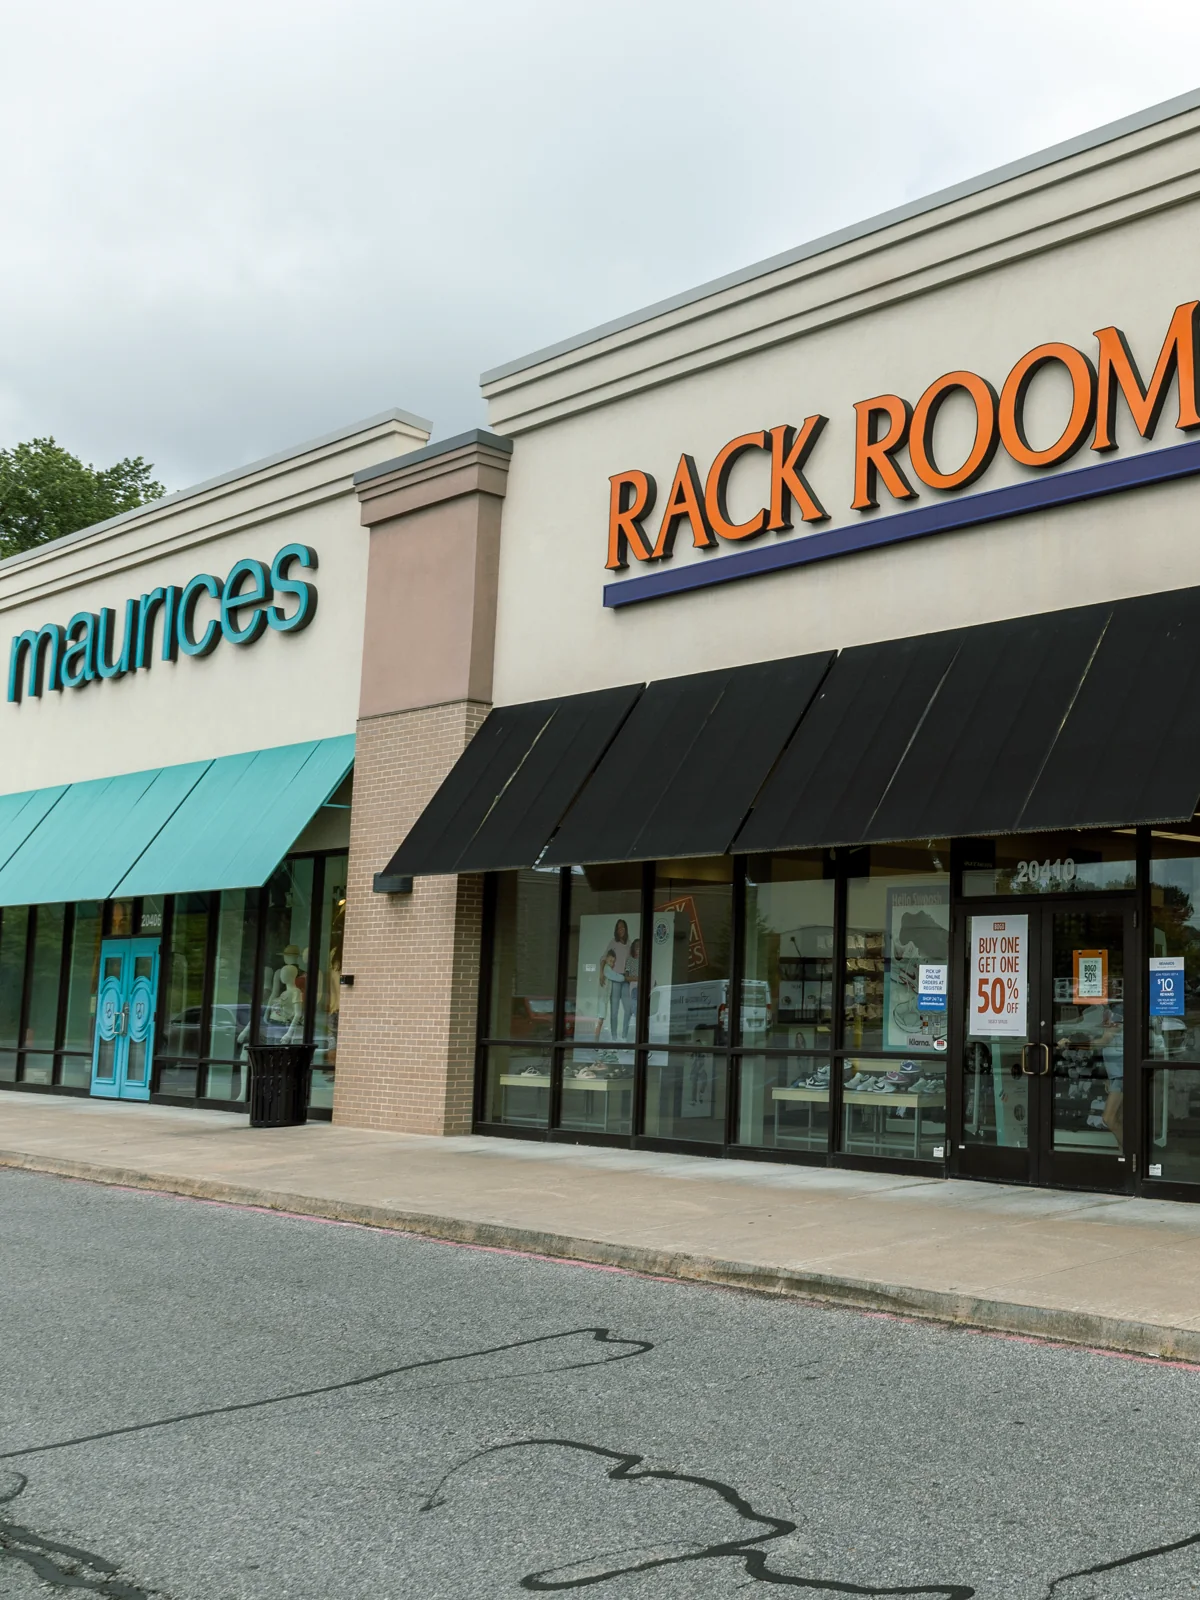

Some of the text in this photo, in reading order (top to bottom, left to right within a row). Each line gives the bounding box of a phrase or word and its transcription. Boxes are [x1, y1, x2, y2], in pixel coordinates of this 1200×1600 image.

[605, 414, 831, 571] RACK
[8, 542, 318, 703] maurices
[1017, 858, 1075, 882] 20410
[141, 914, 162, 927] 20406
[979, 937, 1019, 953] BUY ONE
[978, 956, 1019, 973] GET ONE
[1084, 964, 1097, 972] BOGO
[1157, 977, 1174, 991] $10
[977, 977, 1019, 1014] 50%
[1007, 1002, 1019, 1013] OFF
